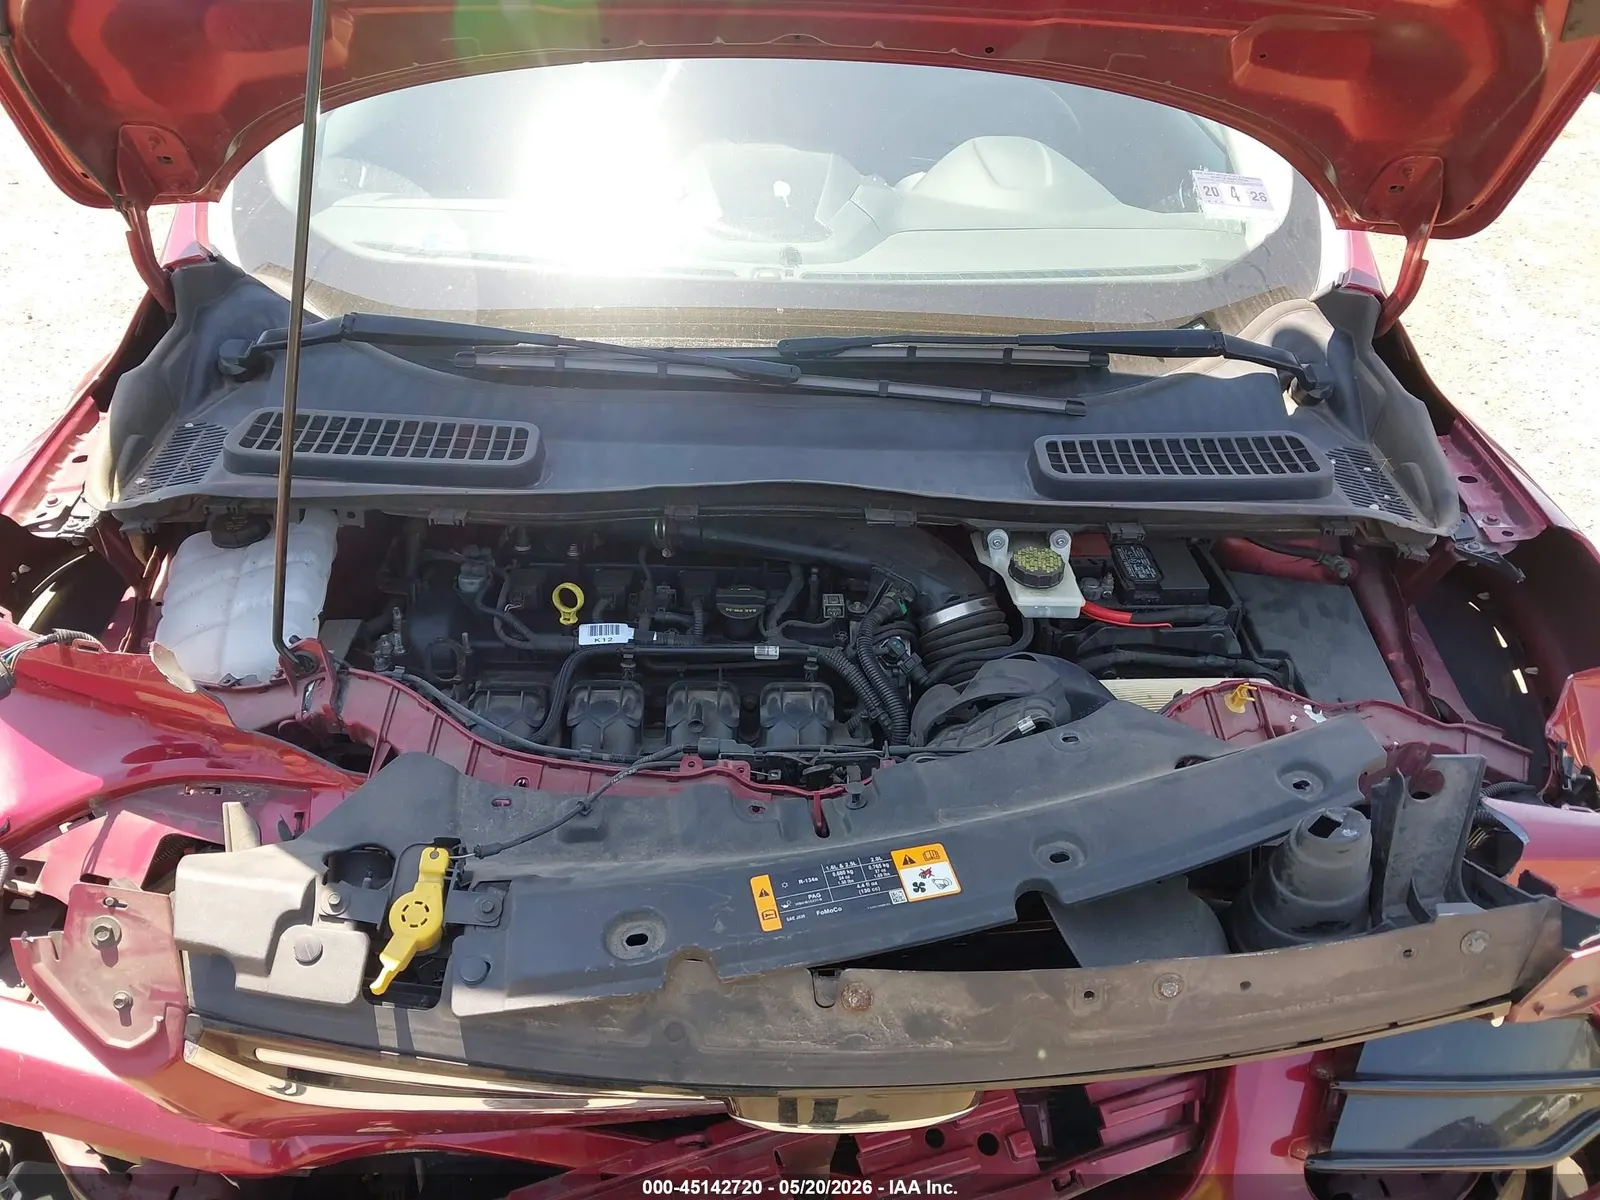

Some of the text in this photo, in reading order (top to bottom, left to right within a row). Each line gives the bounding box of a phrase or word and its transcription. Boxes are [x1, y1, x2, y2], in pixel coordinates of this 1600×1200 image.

[1203, 186, 1220, 197] 20
[1230, 186, 1240, 201] 4
[1250, 191, 1268, 202] 26
[798, 877, 819, 885] R-134a
[807, 892, 822, 900] PAG
[815, 907, 843, 916] FoMoCo
